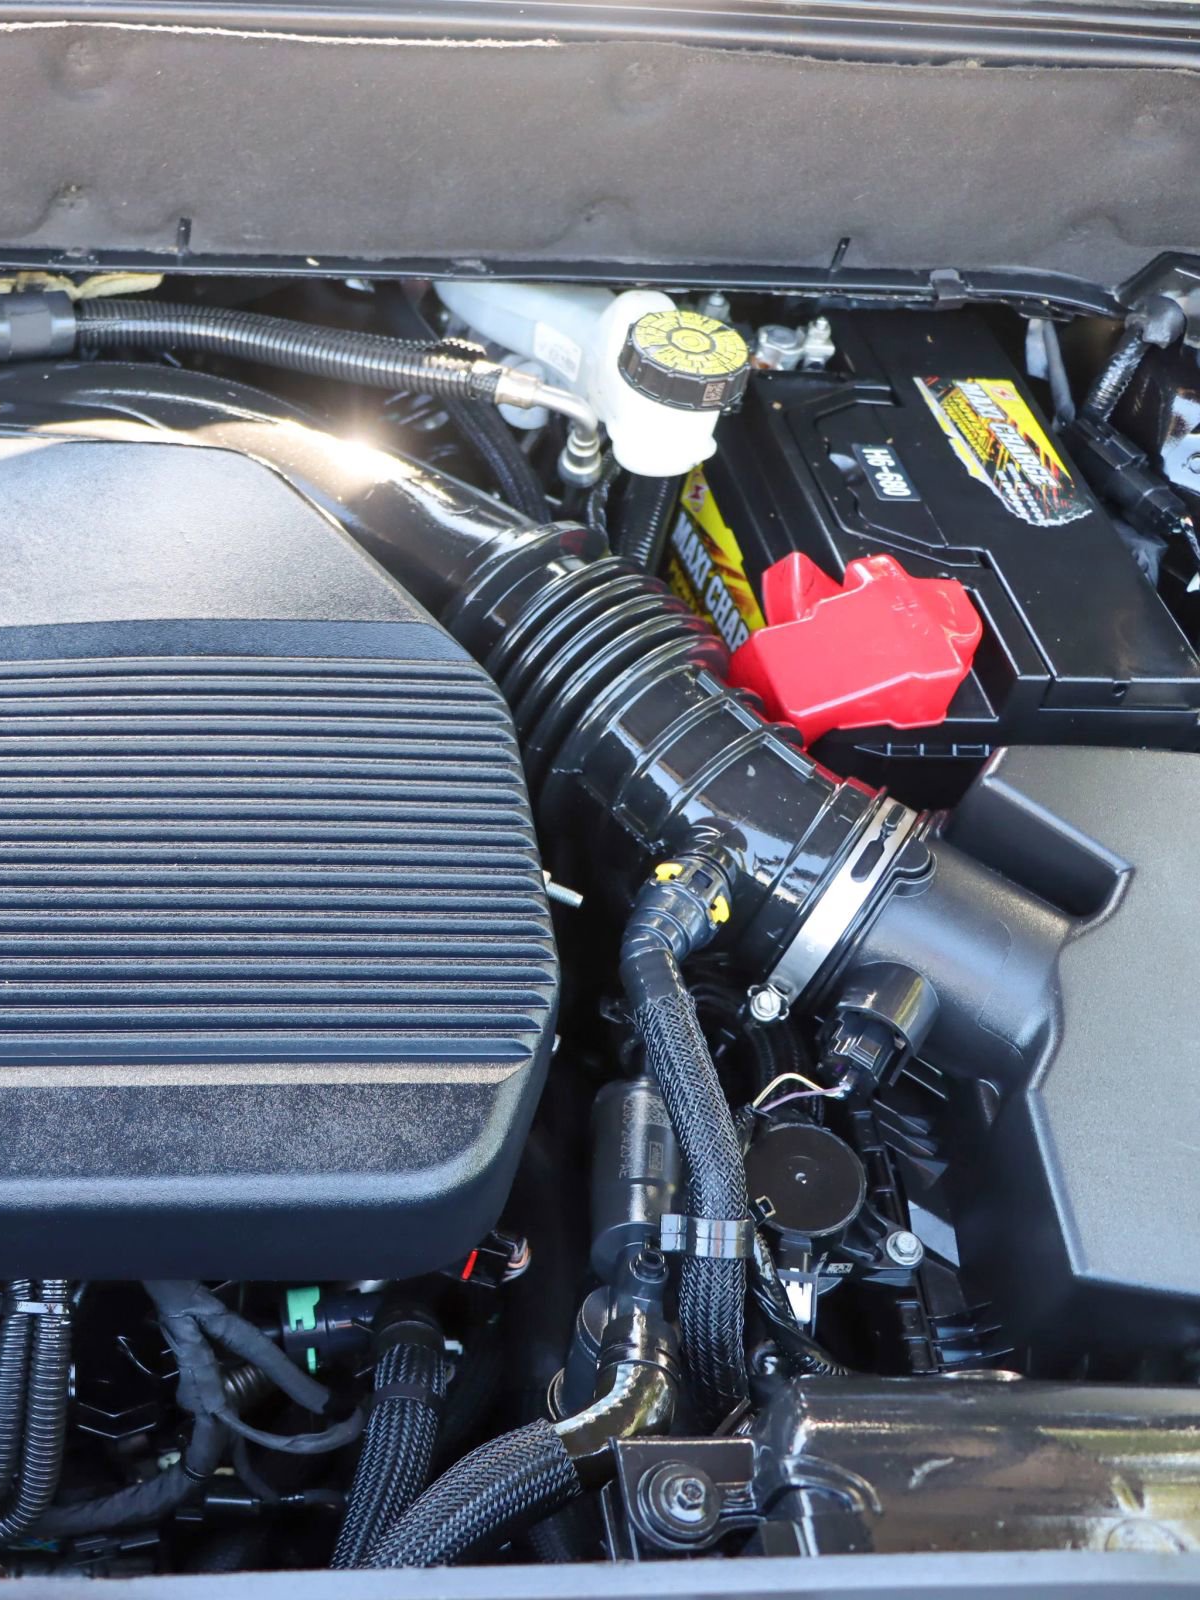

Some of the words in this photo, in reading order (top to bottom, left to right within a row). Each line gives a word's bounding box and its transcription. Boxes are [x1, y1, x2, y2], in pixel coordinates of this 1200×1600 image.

[862, 448, 912, 497] H6-680
[956, 381, 1007, 420] MAXI
[989, 421, 1061, 488] CHARGE
[671, 511, 713, 591] MAXI
[704, 574, 750, 654] CHAR
